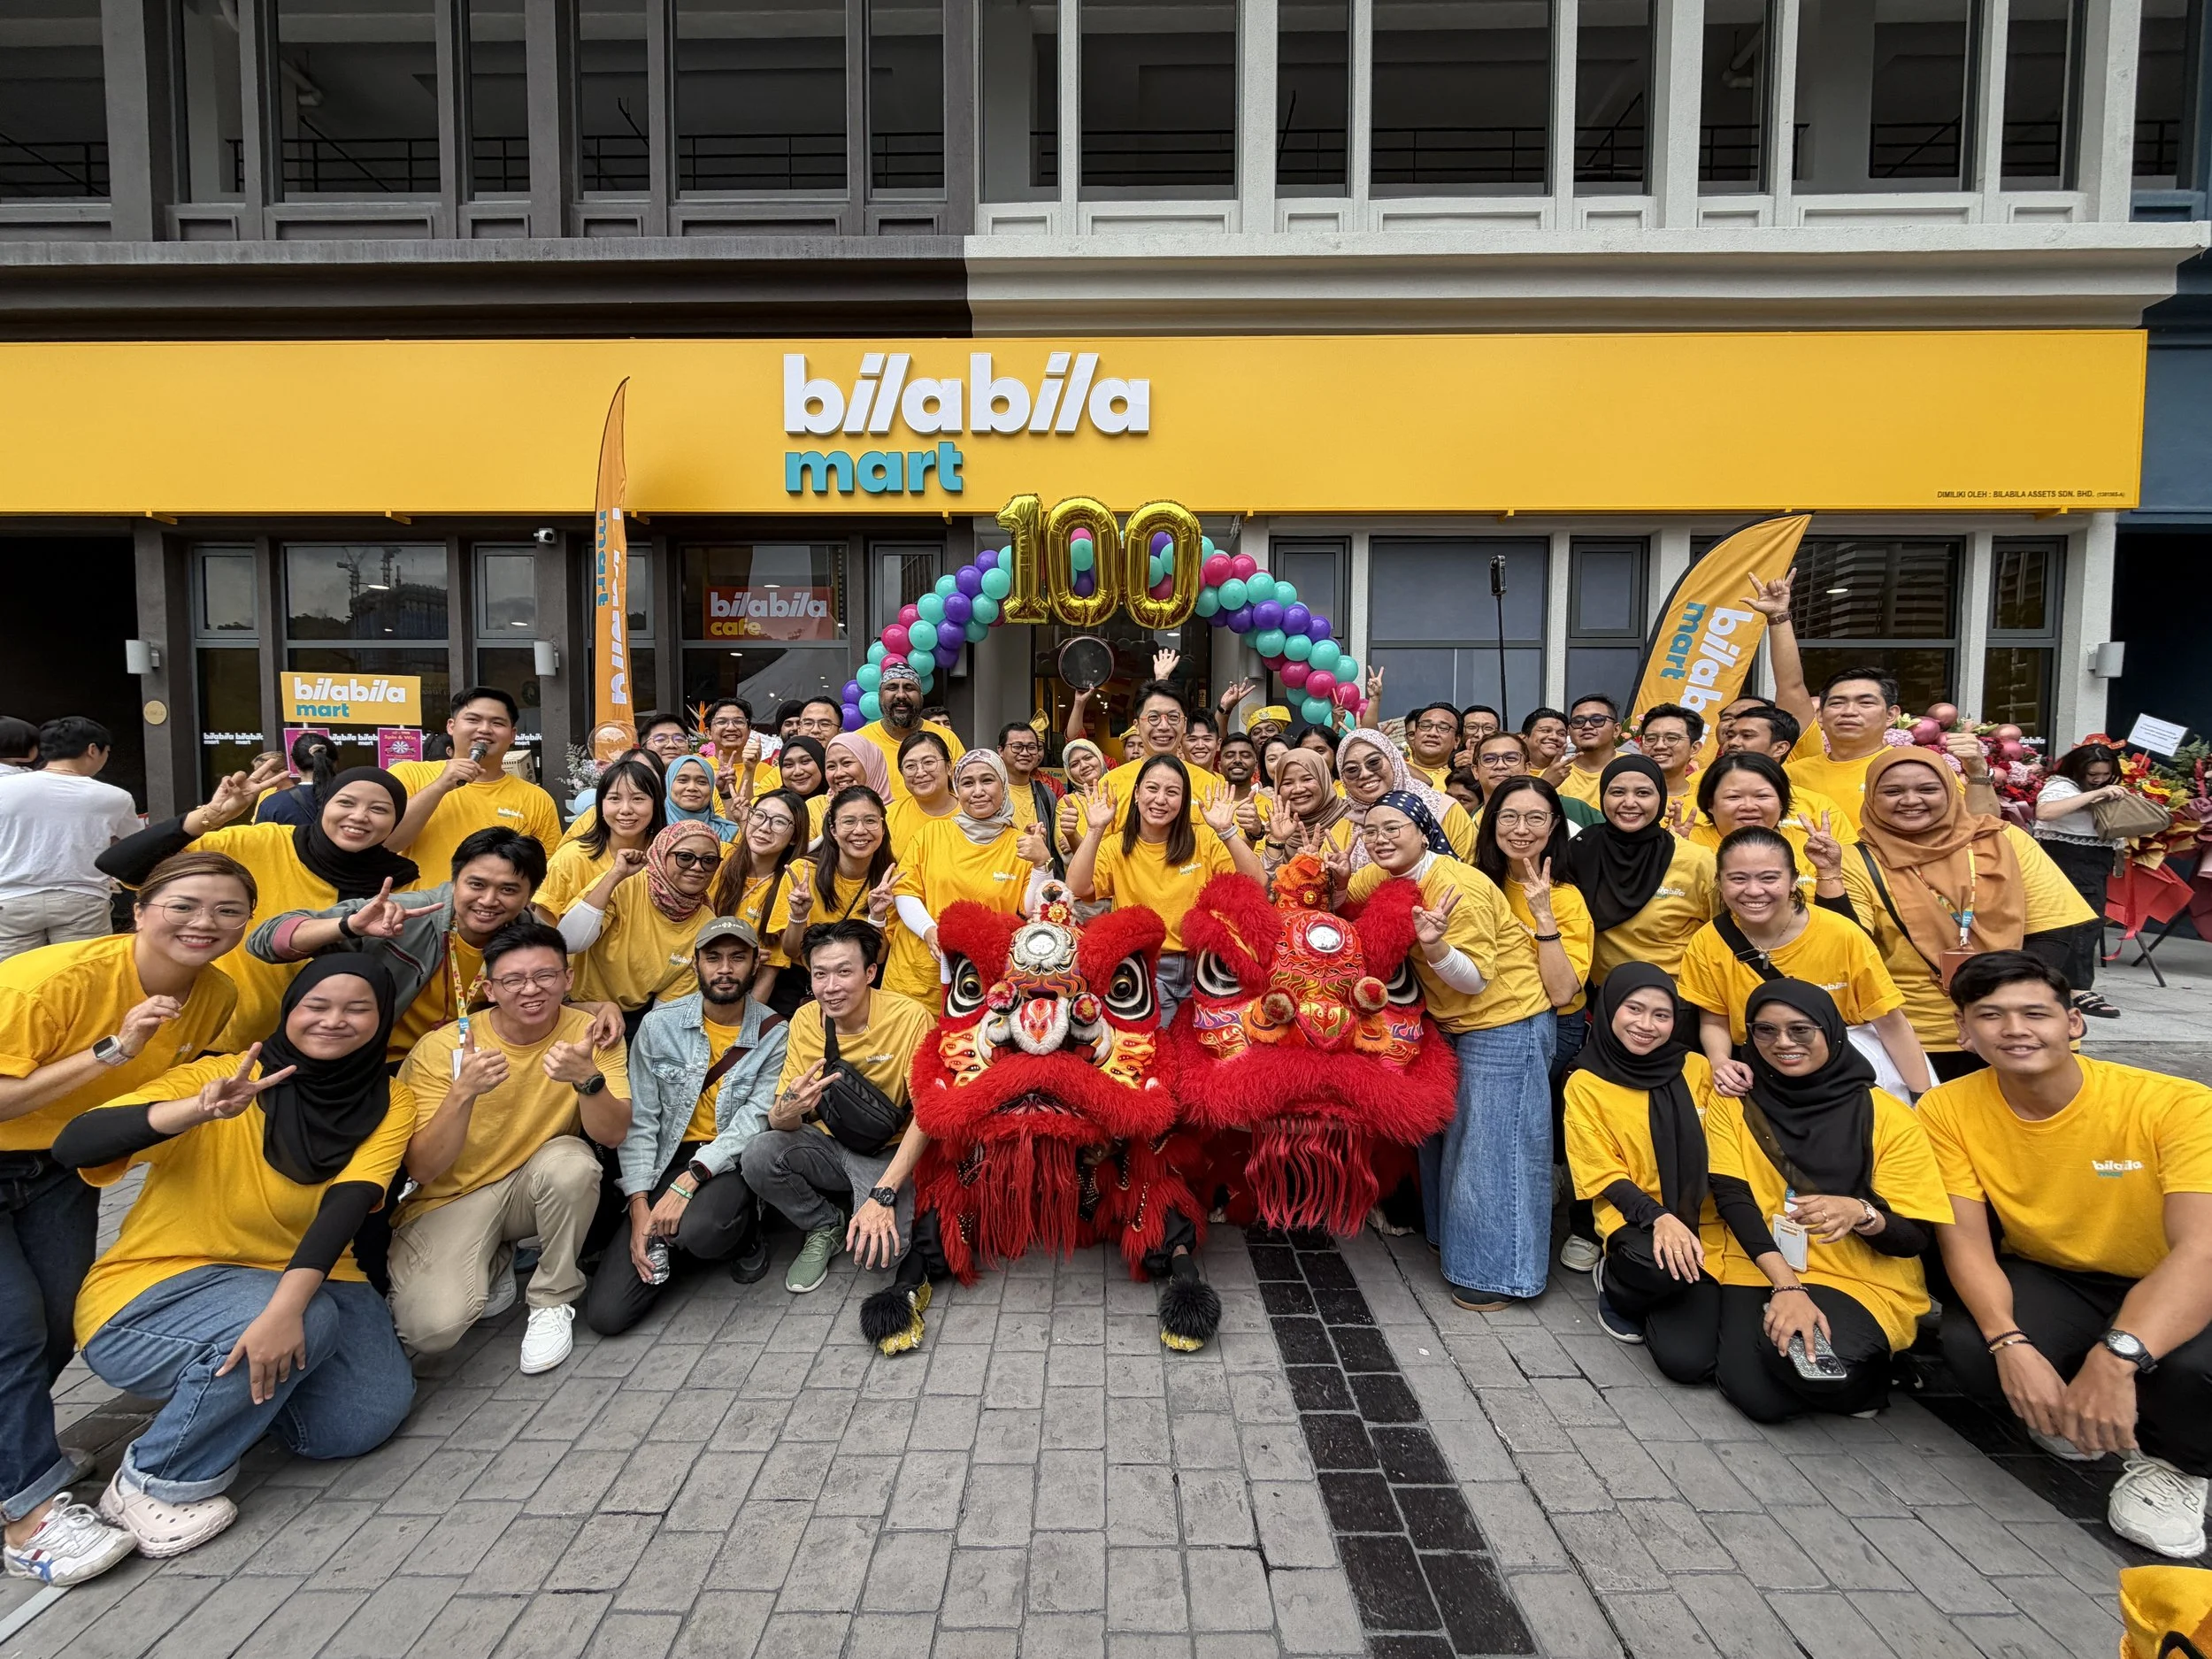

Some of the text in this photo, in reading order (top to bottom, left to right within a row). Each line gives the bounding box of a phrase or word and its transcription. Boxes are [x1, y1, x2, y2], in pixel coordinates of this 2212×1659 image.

[784, 352, 1150, 434] bilabila
[785, 442, 963, 494] mart
[596, 511, 609, 607] mart
[995, 493, 1202, 630] 100
[710, 592, 827, 618] bilabila
[710, 618, 762, 635] cafe
[1660, 602, 1707, 680] mart
[294, 676, 406, 703] bilabila
[296, 703, 349, 718] mart
